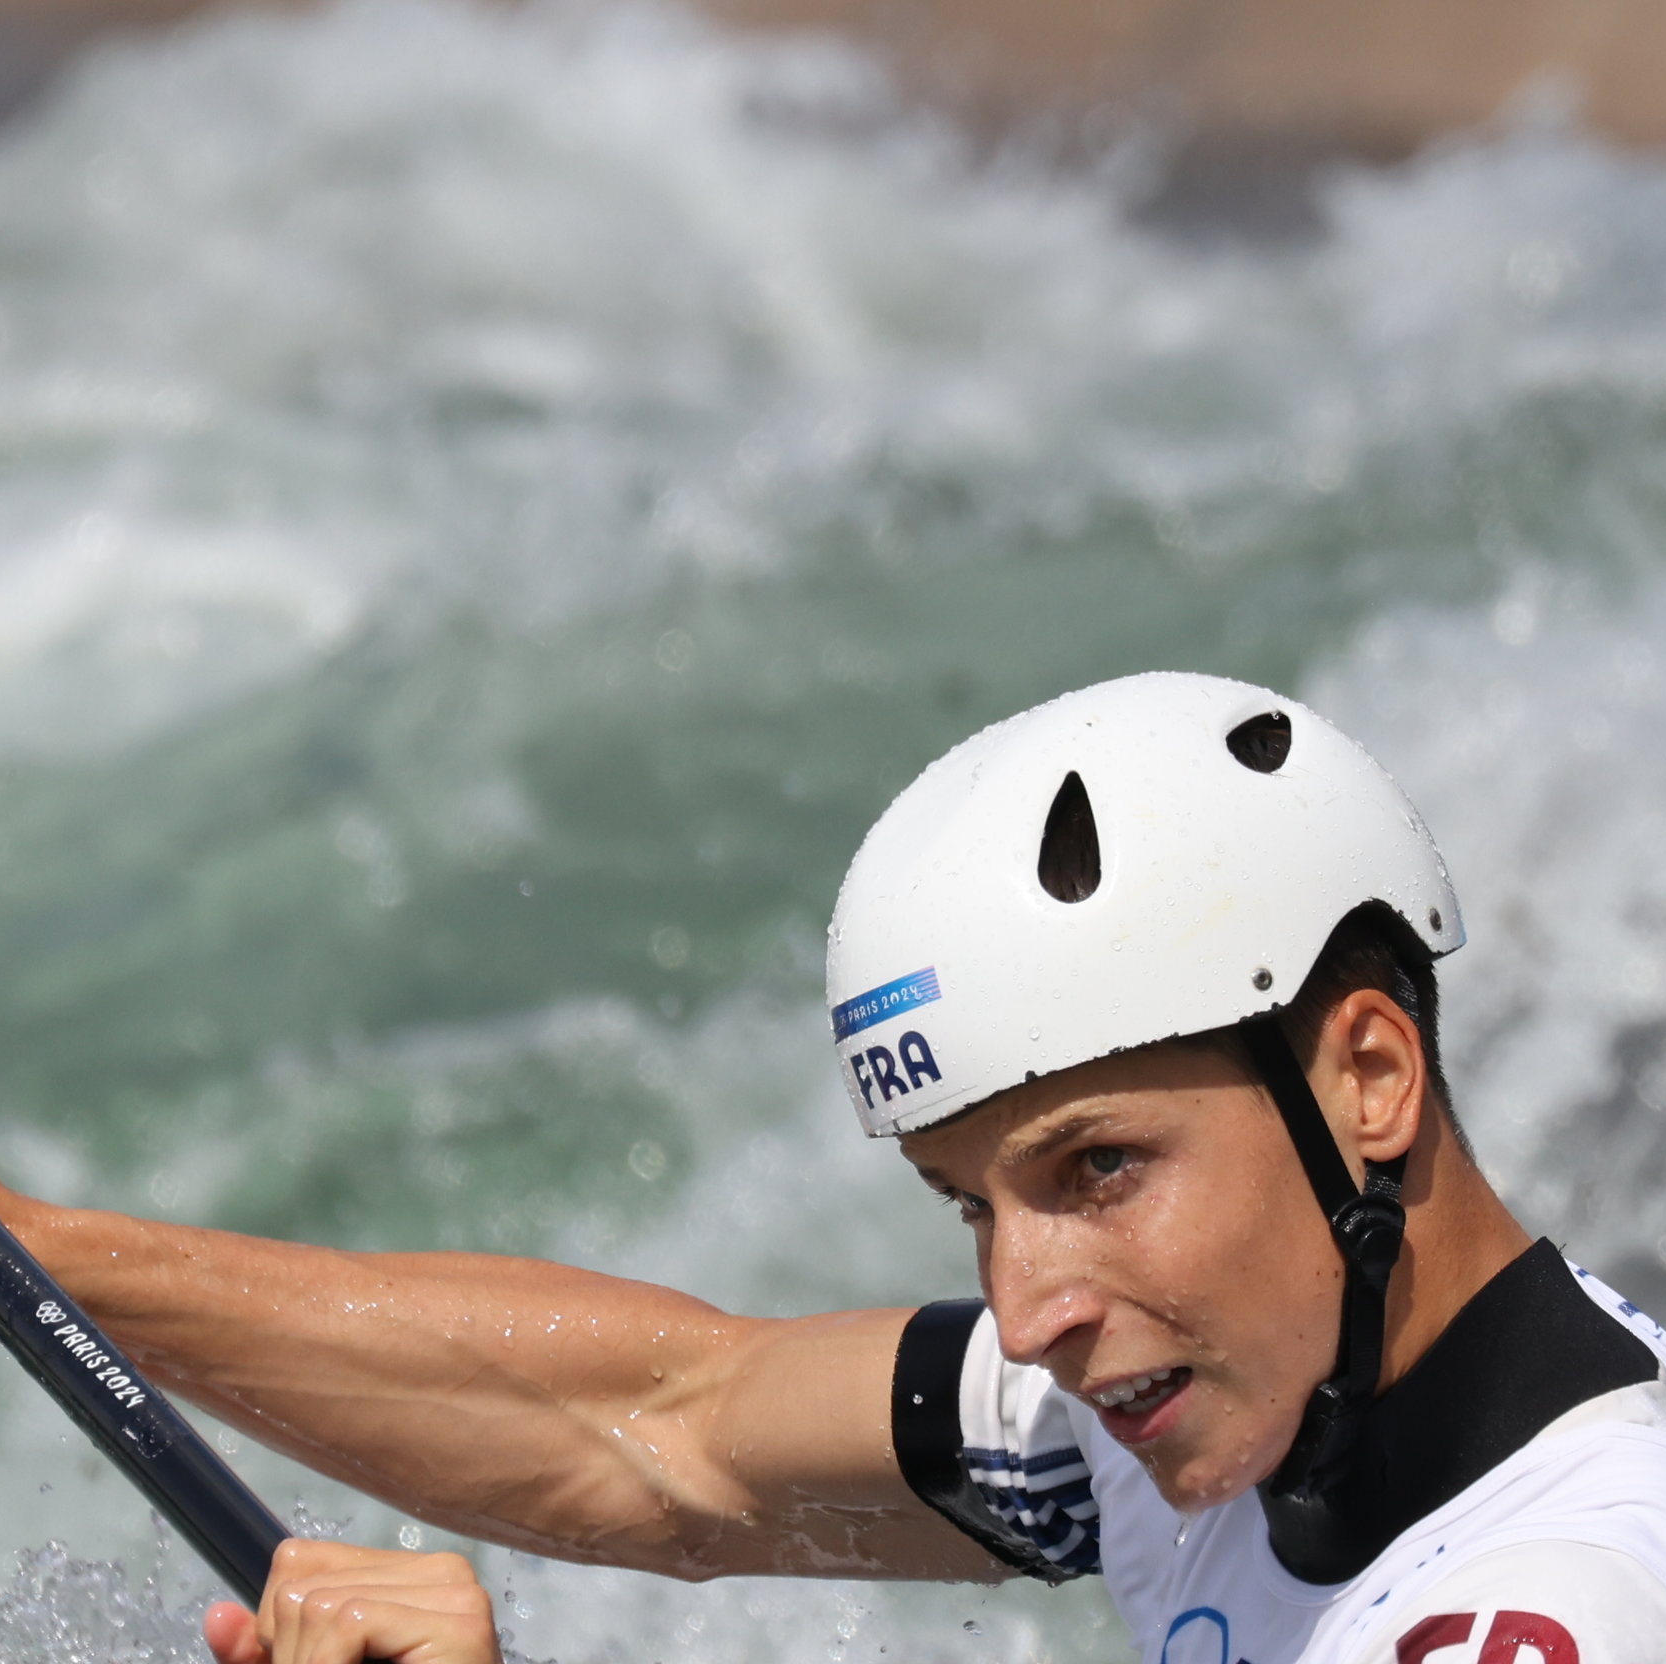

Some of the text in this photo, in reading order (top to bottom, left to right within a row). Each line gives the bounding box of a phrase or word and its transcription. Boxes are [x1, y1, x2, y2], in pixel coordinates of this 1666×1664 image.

[881, 984, 920, 1009] 2024
[850, 1031, 942, 1110] FRA
[96, 1366, 146, 1408] 2024
